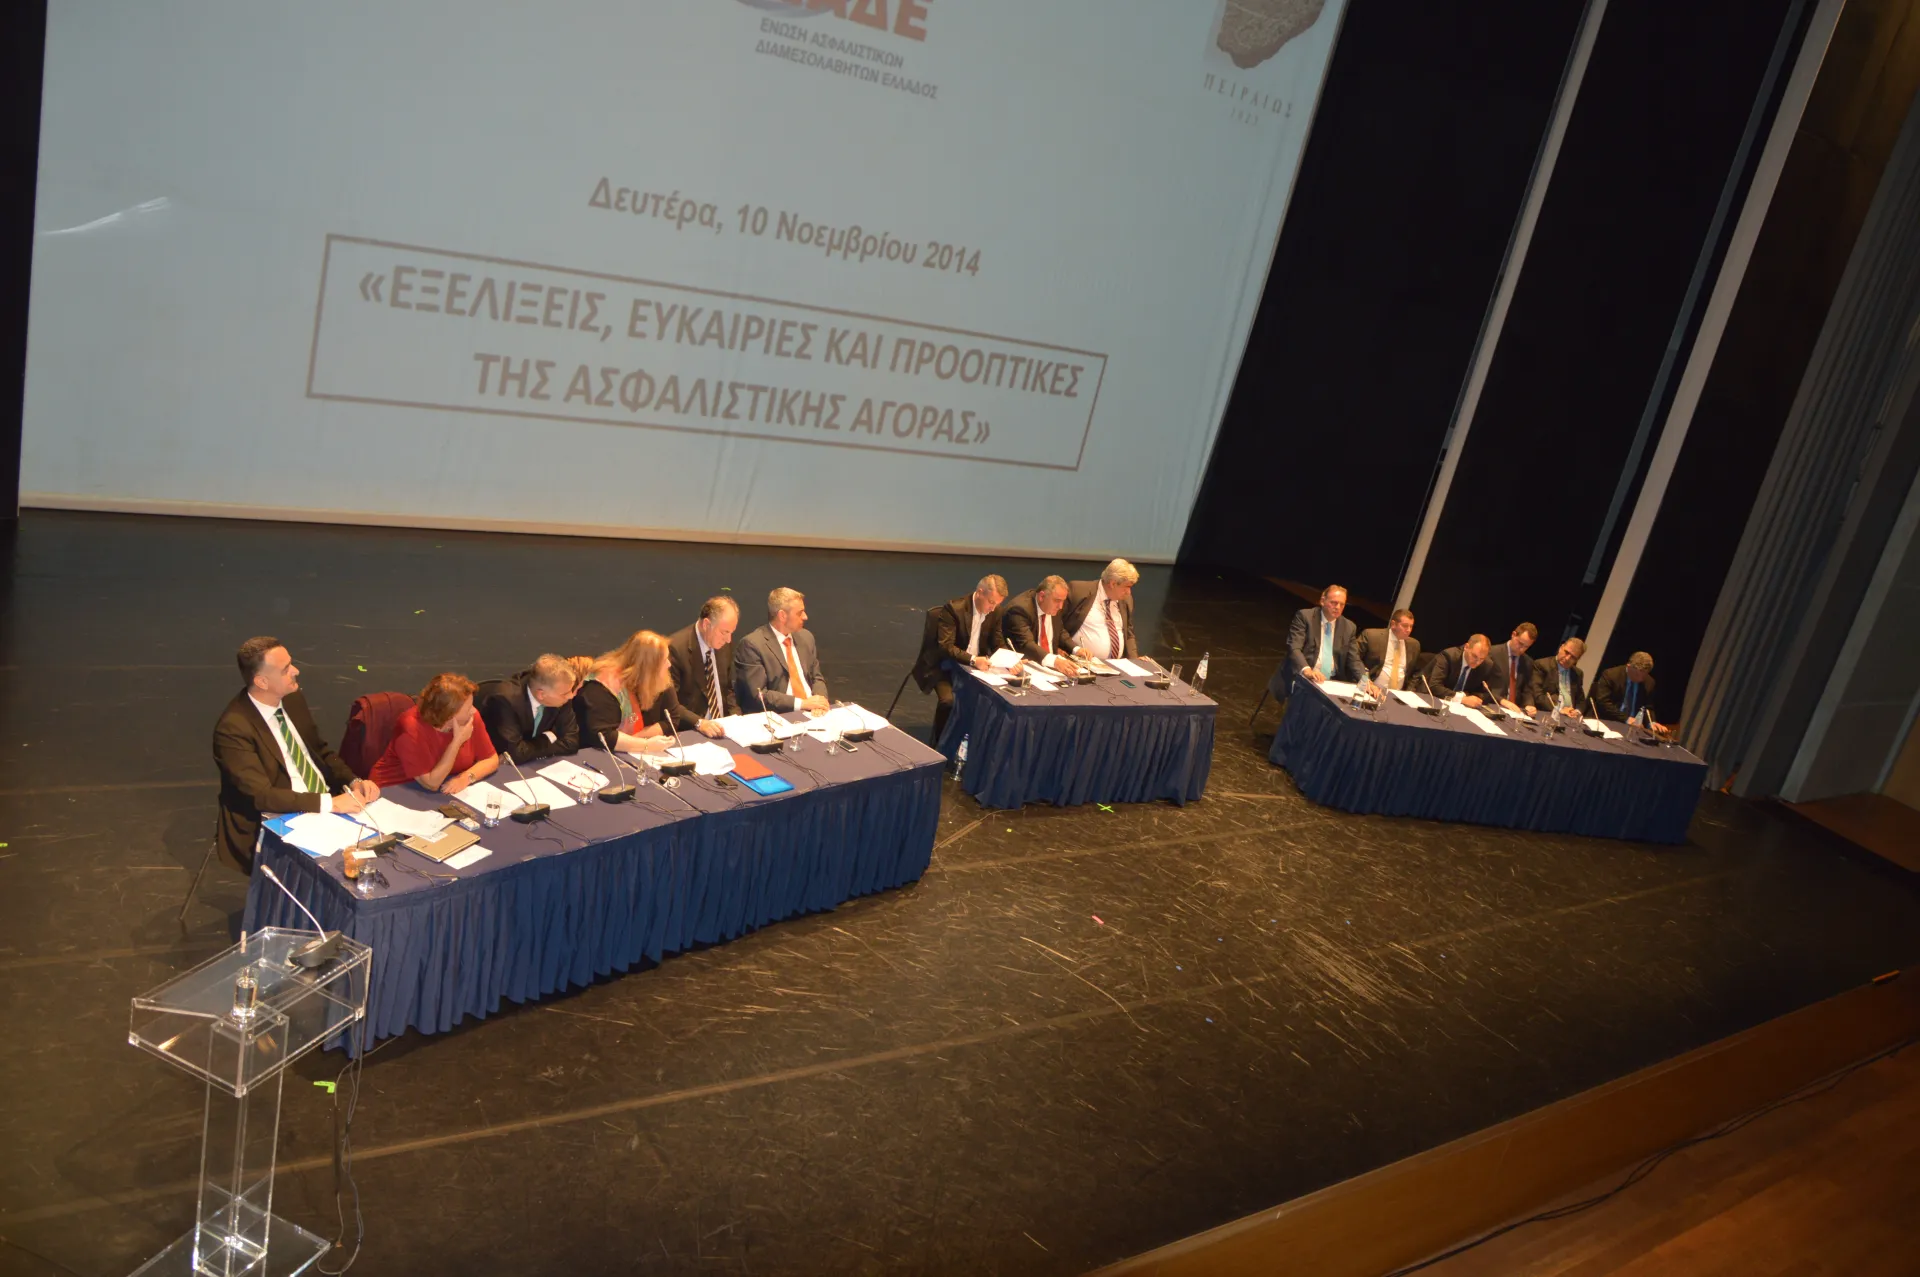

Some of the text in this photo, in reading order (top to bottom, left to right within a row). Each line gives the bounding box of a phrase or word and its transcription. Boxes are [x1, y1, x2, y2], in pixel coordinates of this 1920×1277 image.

[755, 39, 939, 100] ΔΙΑΜΕΣΟΛΑΒΗΤΩΝ ΕΛΛΑΔΟΣ
[759, 17, 904, 69] ΕΝΩΣΗ ΑΣΦΑΛΙΣΤΙΚΩΝ
[588, 176, 982, 277] Δευτέρα, 10 Νοεμβρίου 2014
[358, 265, 1084, 398] «ΕΞΕΛΙΞΕΙΣ, ΕΥΚΑΙΡΙΕΣ ΚΑΙ ΠΡΟΟΠΤΙΚΕΣ
[473, 352, 991, 445] ΤΗΣ ΑΣΦΑΛΙΣΤΙΚΗΣ ΑΓΟΡΑΣ»
